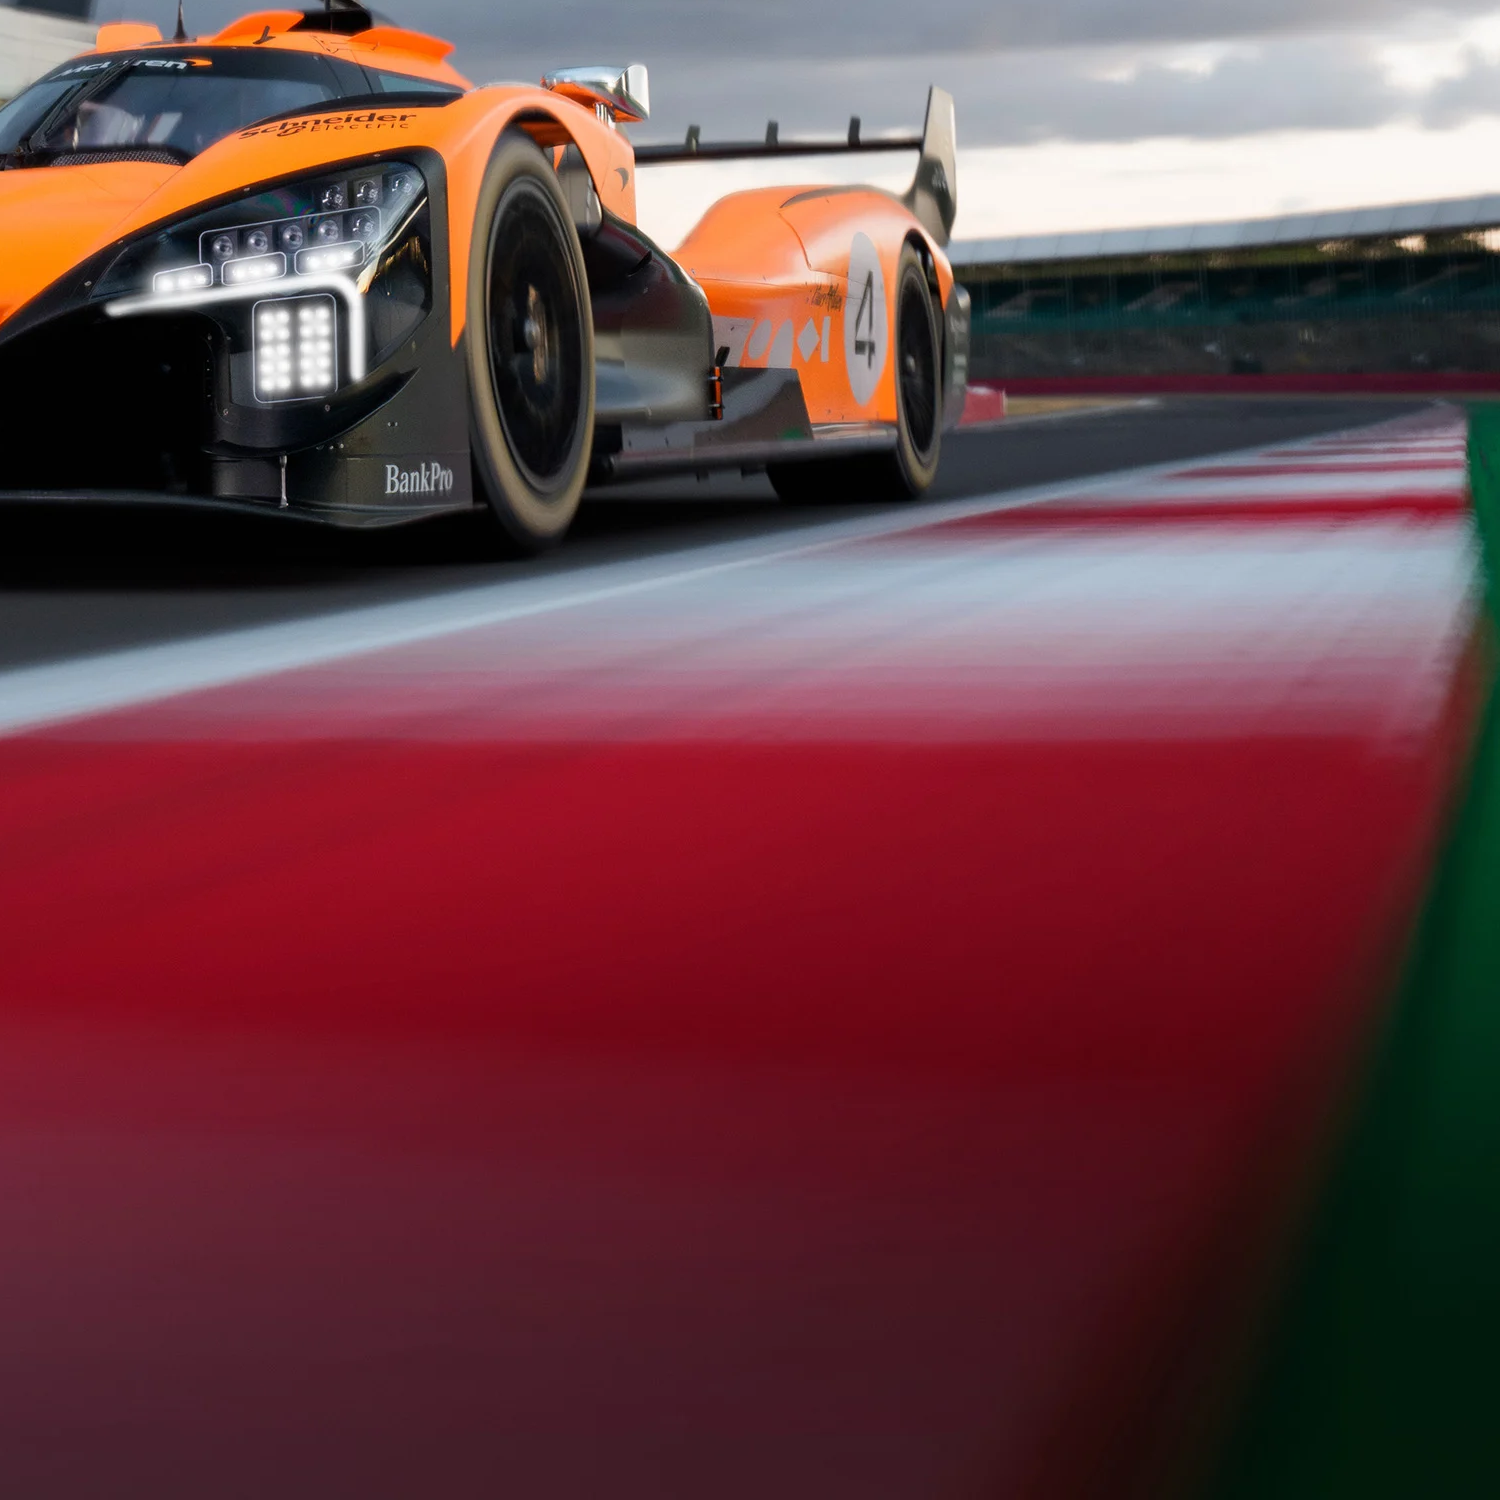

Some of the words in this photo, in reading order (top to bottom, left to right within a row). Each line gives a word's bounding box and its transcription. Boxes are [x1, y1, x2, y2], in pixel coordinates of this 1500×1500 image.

[238, 112, 417, 139] Schneider
[311, 122, 409, 132] Electric
[854, 270, 876, 370] 4
[385, 462, 453, 494] BankPro
